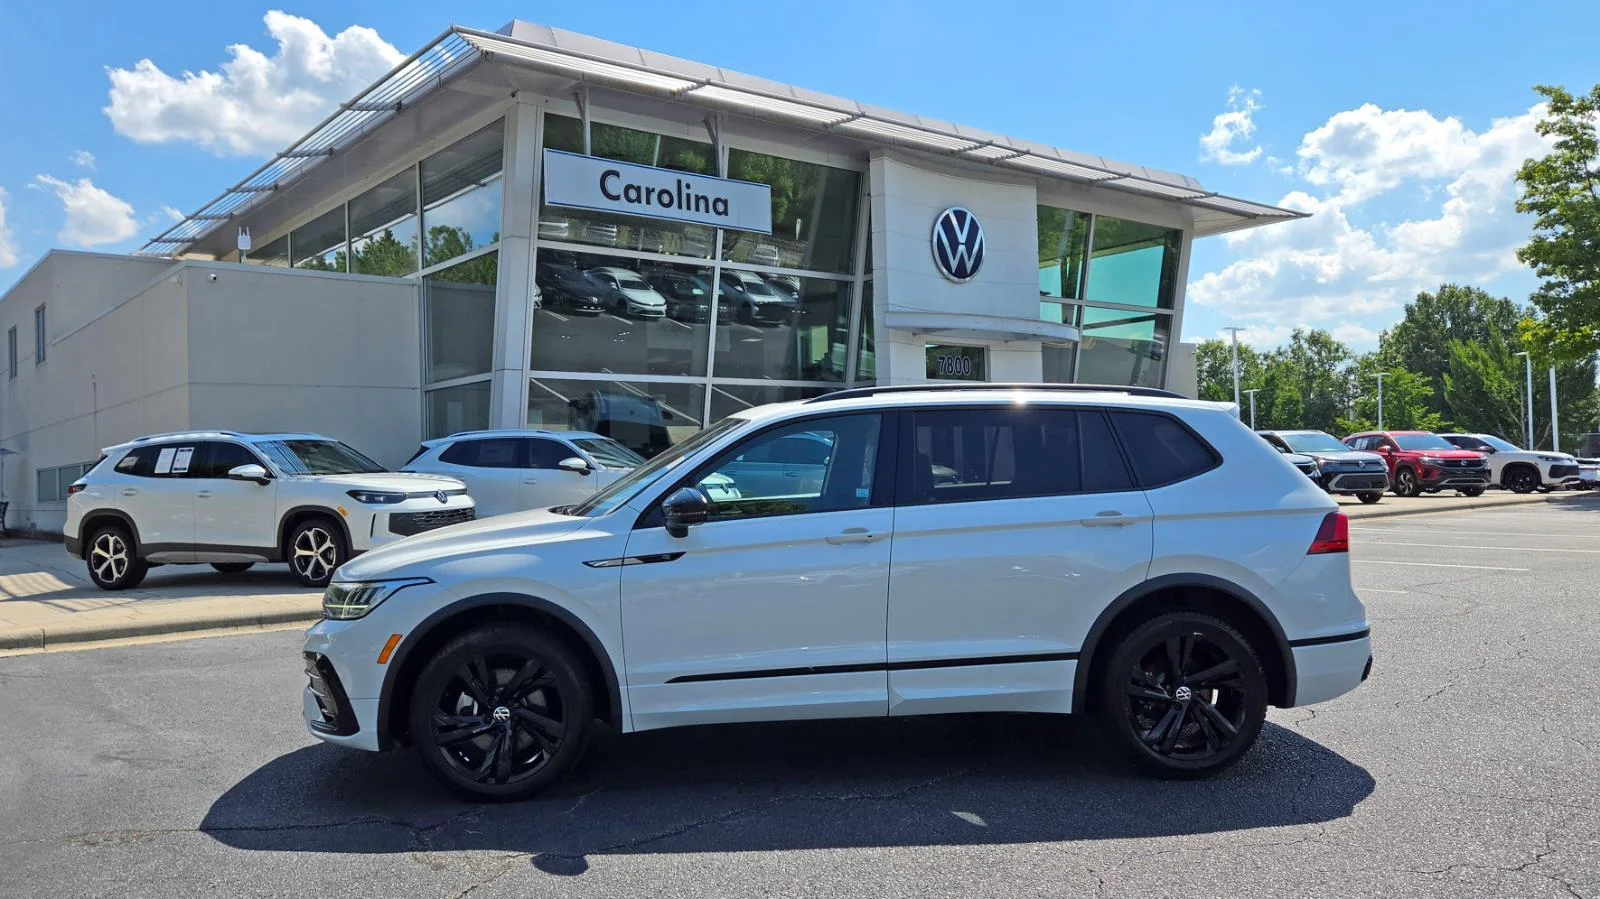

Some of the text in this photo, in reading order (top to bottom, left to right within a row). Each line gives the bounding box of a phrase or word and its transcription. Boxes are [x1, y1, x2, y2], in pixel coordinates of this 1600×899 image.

[600, 169, 729, 217] Carolina
[934, 208, 985, 281] VW
[938, 354, 971, 376] 7800
